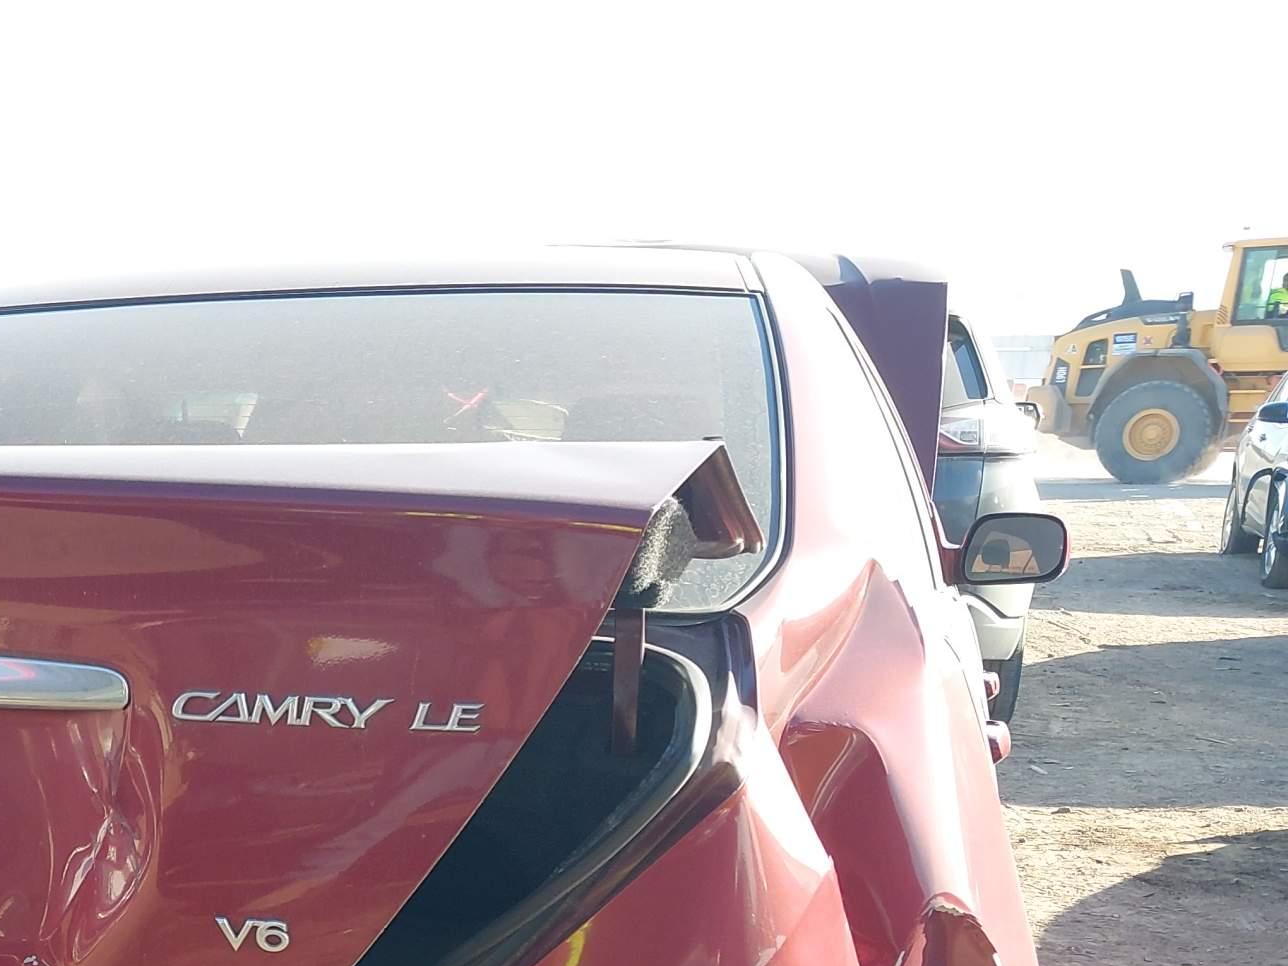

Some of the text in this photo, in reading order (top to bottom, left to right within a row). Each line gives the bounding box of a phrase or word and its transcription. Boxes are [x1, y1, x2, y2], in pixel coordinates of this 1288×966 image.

[171, 691, 485, 732] CAMRY LE
[214, 916, 290, 953] V6
